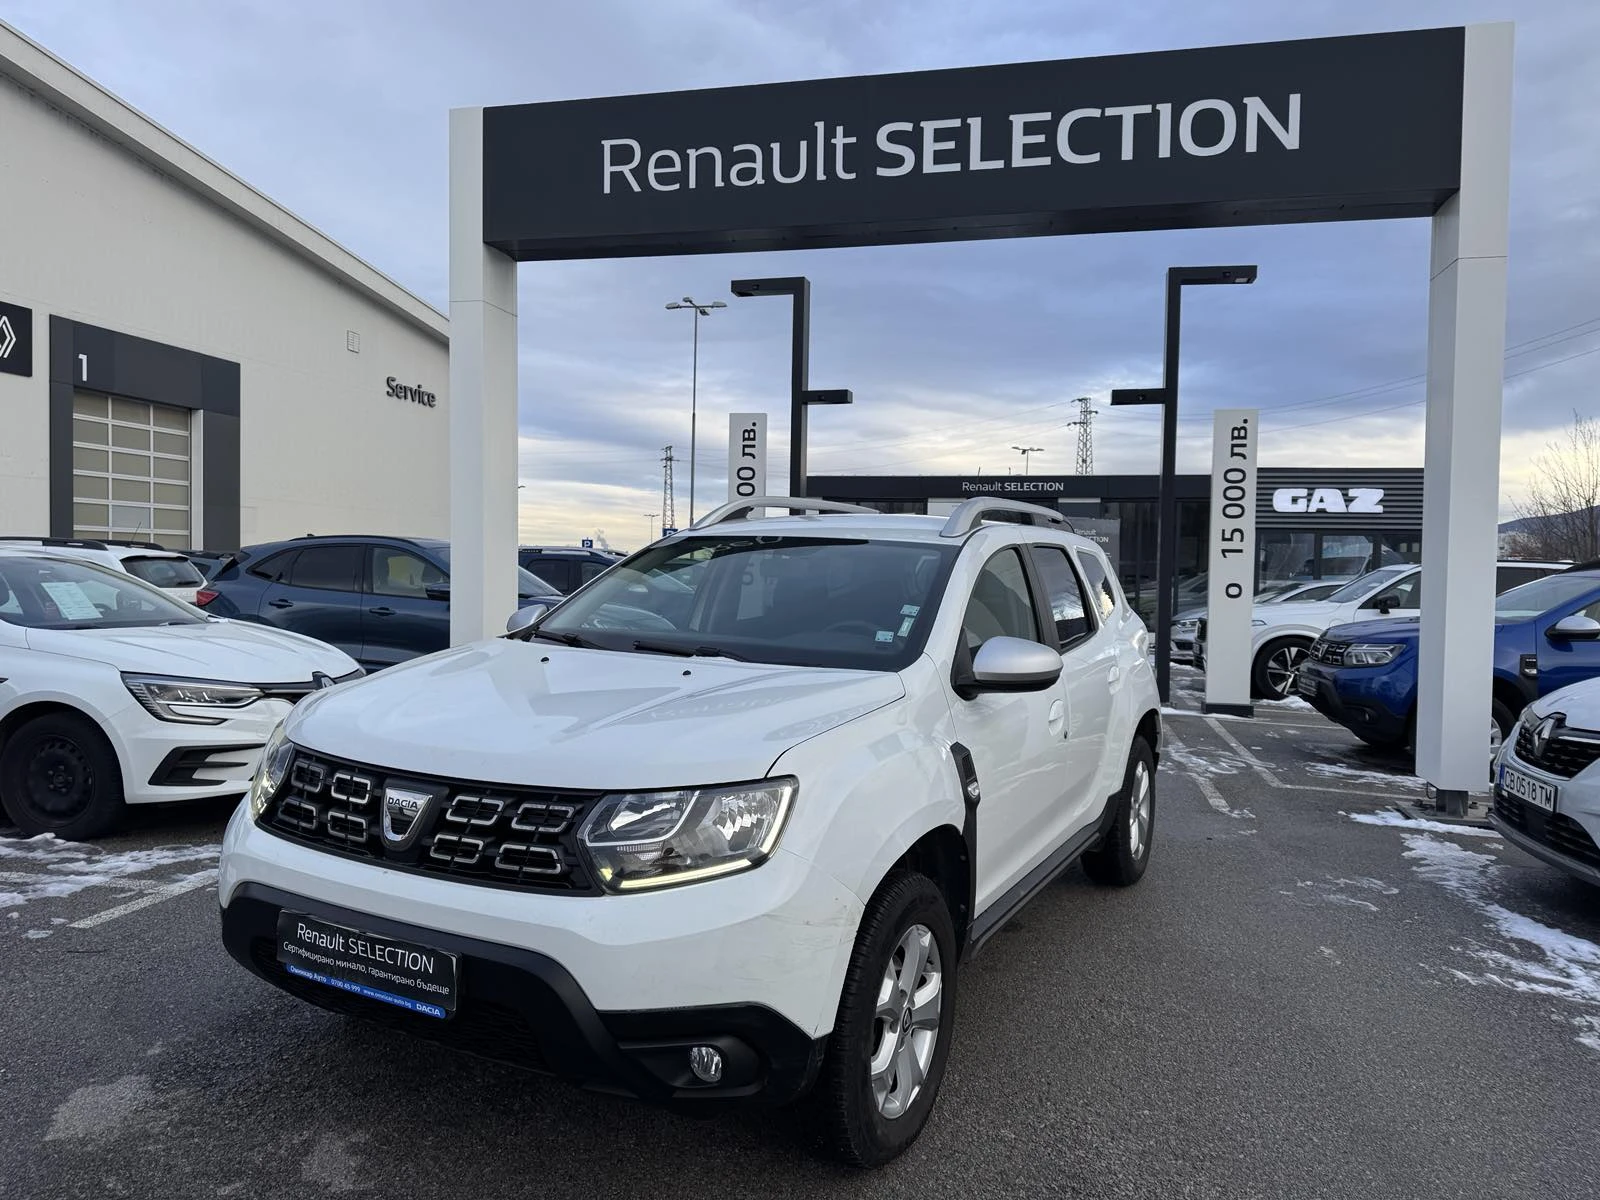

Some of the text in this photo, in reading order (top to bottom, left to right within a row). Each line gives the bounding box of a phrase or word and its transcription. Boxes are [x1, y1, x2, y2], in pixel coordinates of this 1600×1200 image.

[601, 93, 1302, 194] Renault SELECTION
[78, 353, 87, 382] 1
[386, 376, 436, 408] Service
[742, 422, 757, 460] лв.
[1230, 418, 1248, 460] лв.
[962, 481, 1065, 492] Renault SELECTION
[1222, 467, 1247, 519] 000
[1272, 488, 1385, 513] GAZ
[1220, 527, 1245, 559] 15
[387, 796, 418, 810] DACIA
[1516, 775, 1537, 801] 0518
[297, 922, 434, 974] Renault SELECTION
[283, 941, 450, 995] Сертифицирано минало, гарантирано бъдеще
[330, 978, 343, 988] 0700
[416, 1003, 441, 1016] DACIA
